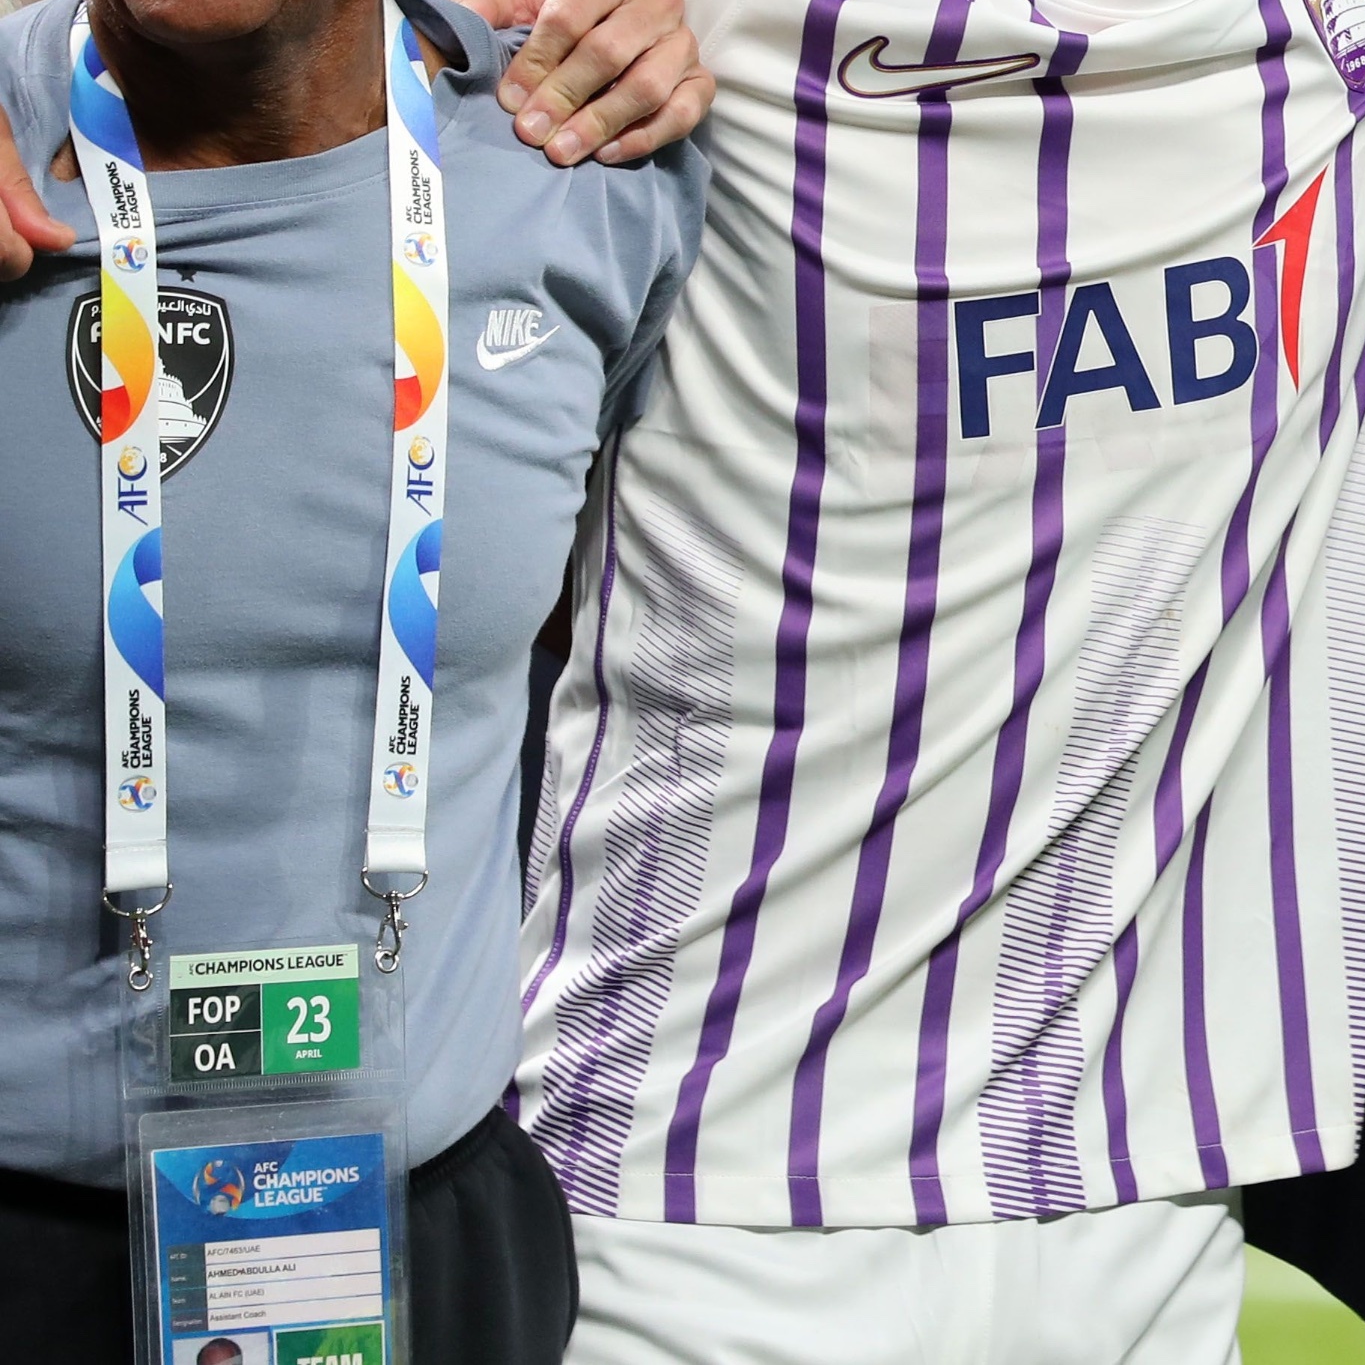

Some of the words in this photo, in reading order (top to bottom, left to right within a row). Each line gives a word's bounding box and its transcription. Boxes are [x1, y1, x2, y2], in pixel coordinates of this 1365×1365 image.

[105, 161, 130, 229] CHAMPIONS
[124, 182, 141, 228] LEAGUE
[410, 149, 422, 224] CHAMPIONS
[422, 176, 432, 225] LEAGUE
[177, 322, 211, 345] FC
[486, 309, 543, 346] NIKE
[118, 445, 148, 526] AFC
[406, 435, 435, 516] AFC
[129, 689, 141, 768] CHAMPIONS
[396, 675, 411, 755] CHAMPIONS
[407, 704, 420, 755] LEAGUE
[142, 716, 152, 768] LEAGUE
[195, 957, 284, 976] CHAMPIONS
[287, 954, 345, 969] LEAGUE
[188, 995, 241, 1025] FOP
[286, 995, 332, 1044] 23
[194, 1043, 236, 1072] OA
[295, 1049, 323, 1059] APRIL
[253, 1161, 278, 1174] AFC
[253, 1166, 360, 1190] CHAMPIONS
[254, 1189, 324, 1207] LEAGUE
